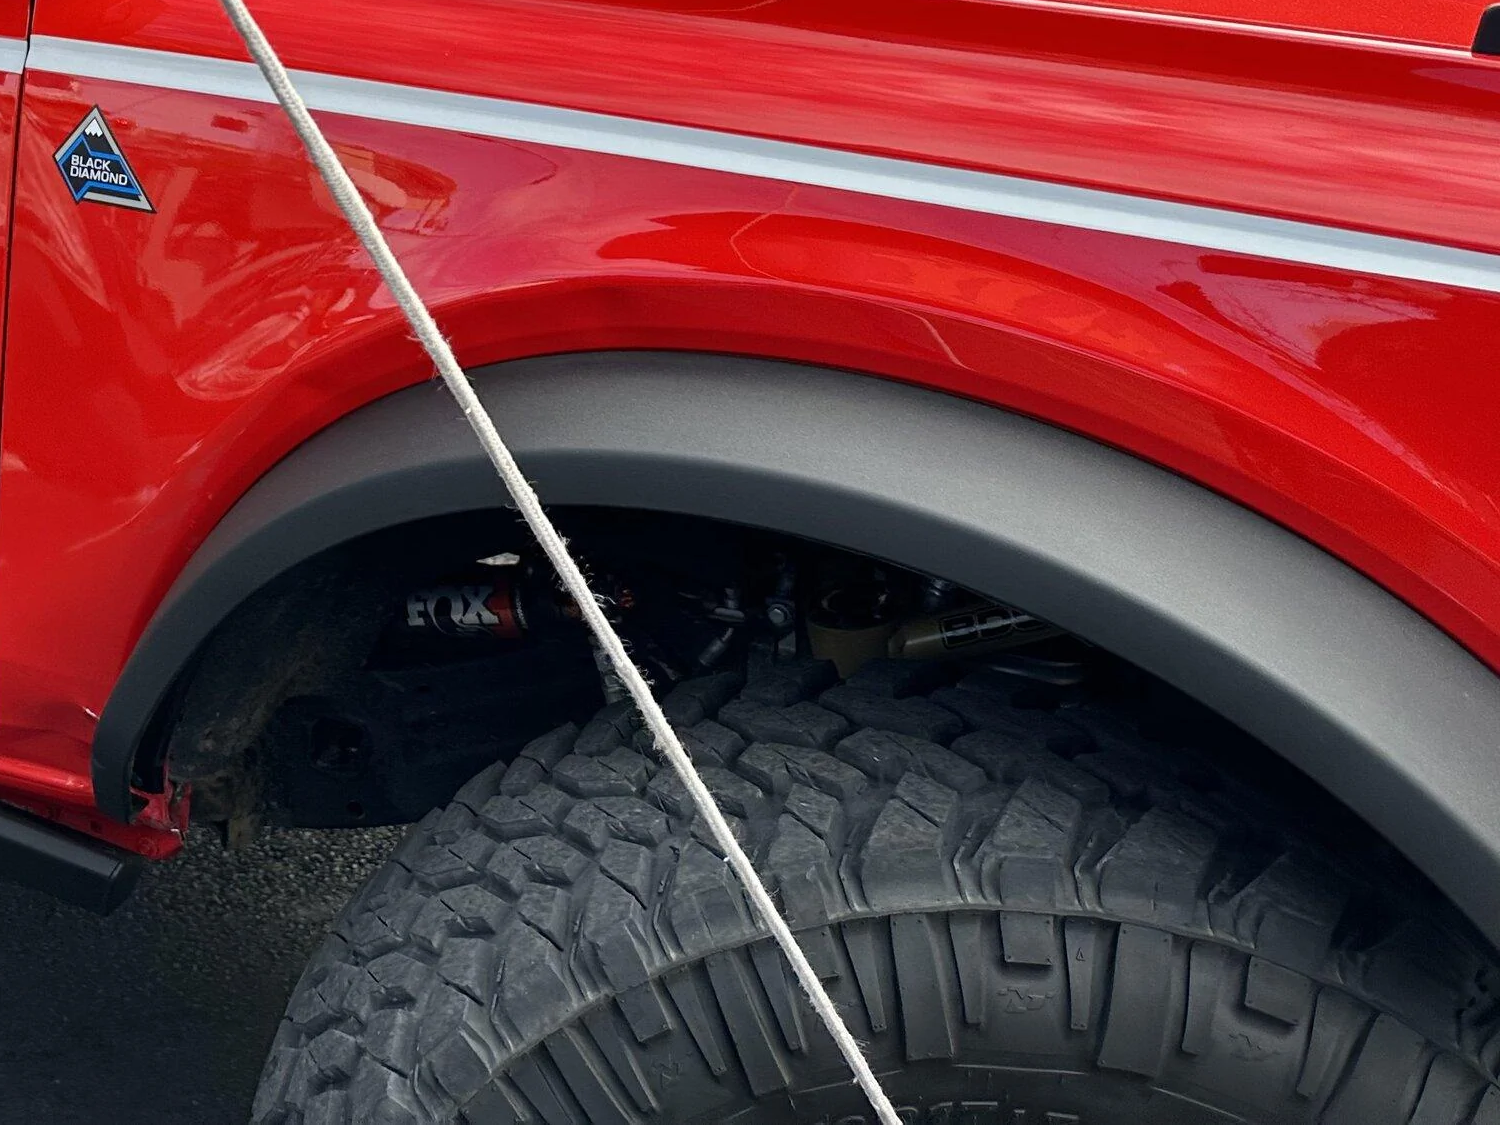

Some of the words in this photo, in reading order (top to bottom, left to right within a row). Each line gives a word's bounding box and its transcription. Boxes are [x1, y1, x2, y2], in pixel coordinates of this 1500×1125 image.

[70, 154, 111, 172] BLACK
[69, 165, 128, 186] DIAMOND
[406, 585, 500, 635] FOX
